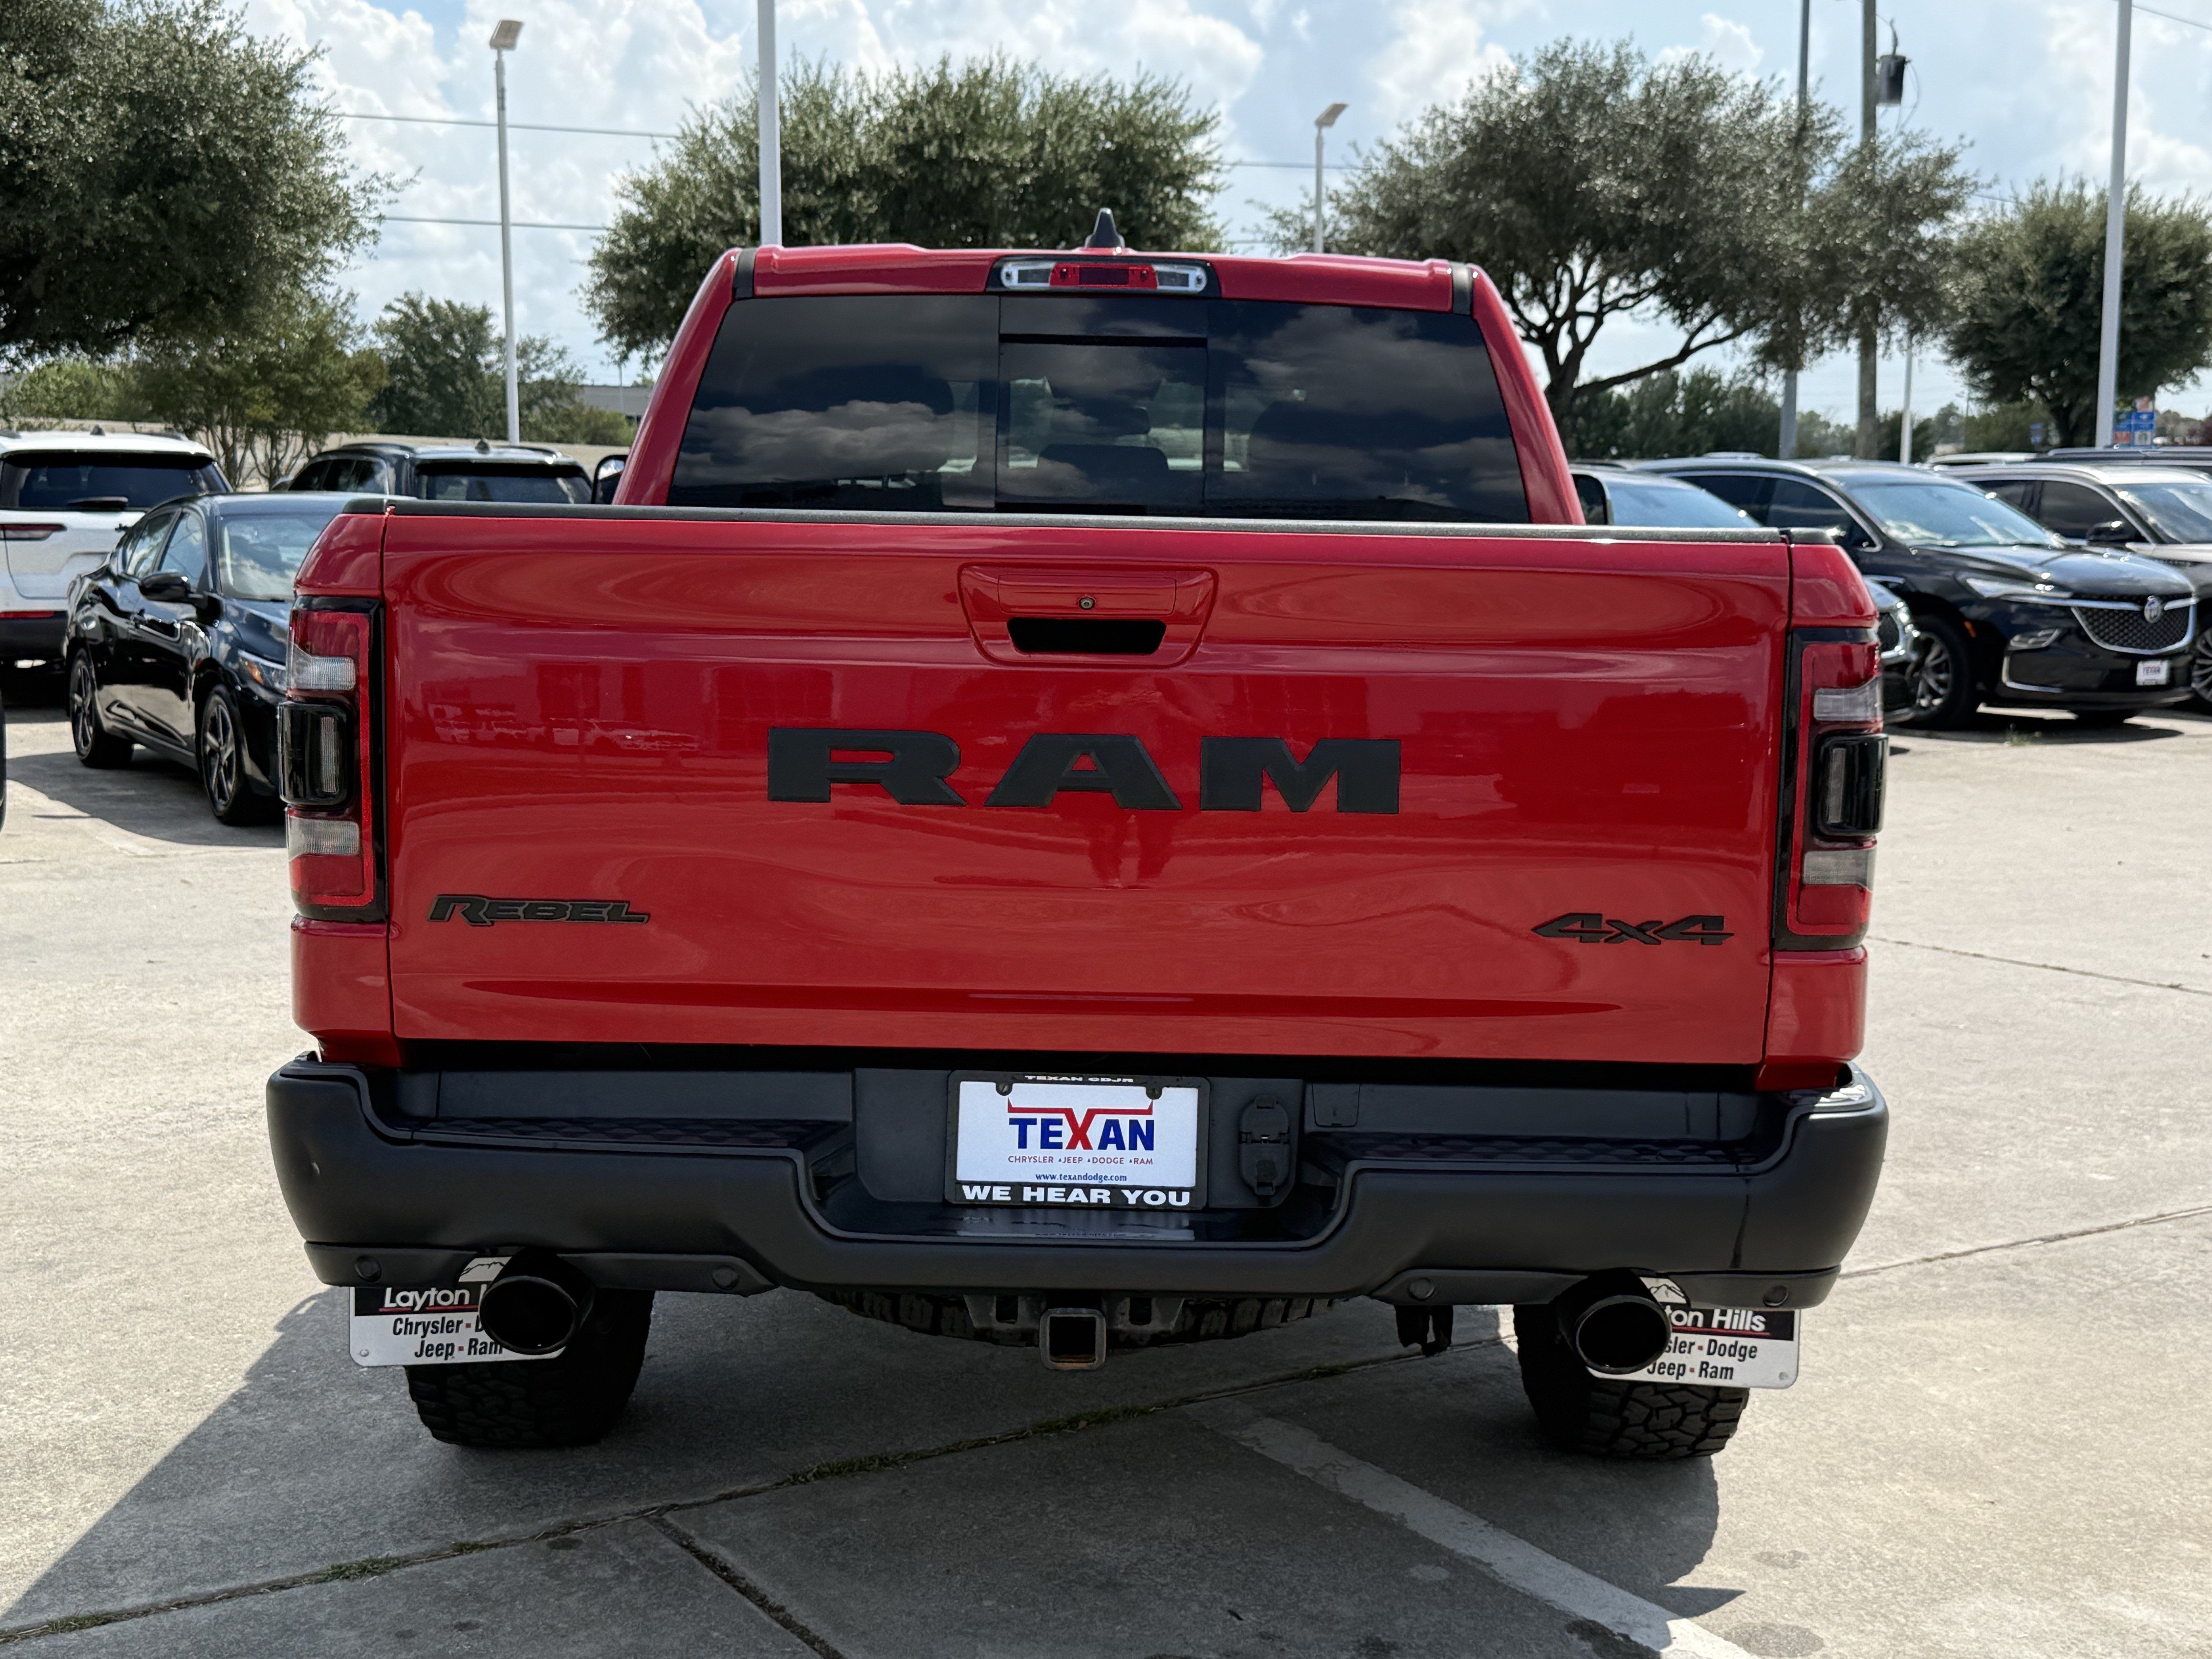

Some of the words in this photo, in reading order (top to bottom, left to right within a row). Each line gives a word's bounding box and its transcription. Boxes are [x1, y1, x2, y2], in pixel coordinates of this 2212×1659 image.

[767, 727, 1401, 814] RAM
[428, 894, 650, 926] REBEL
[1009, 1108, 1154, 1151] TEXAN
[1008, 1156, 1054, 1164] CHRYSLER
[1036, 1172, 1127, 1183] www.texandodge.com
[962, 1185, 1011, 1201] WE
[1023, 1187, 1111, 1204] HEAR
[1121, 1189, 1190, 1206] YOU
[384, 1287, 470, 1311] Layton
[393, 1317, 464, 1338] Chrysler
[1664, 1305, 1704, 1327] ton
[1711, 1309, 1766, 1332] Hills
[414, 1340, 455, 1360] Jeep
[467, 1338, 503, 1355] Ram
[1706, 1339, 1758, 1362] Dodge
[1647, 1362, 1686, 1380] Jeep
[1698, 1361, 1734, 1380] Ram
